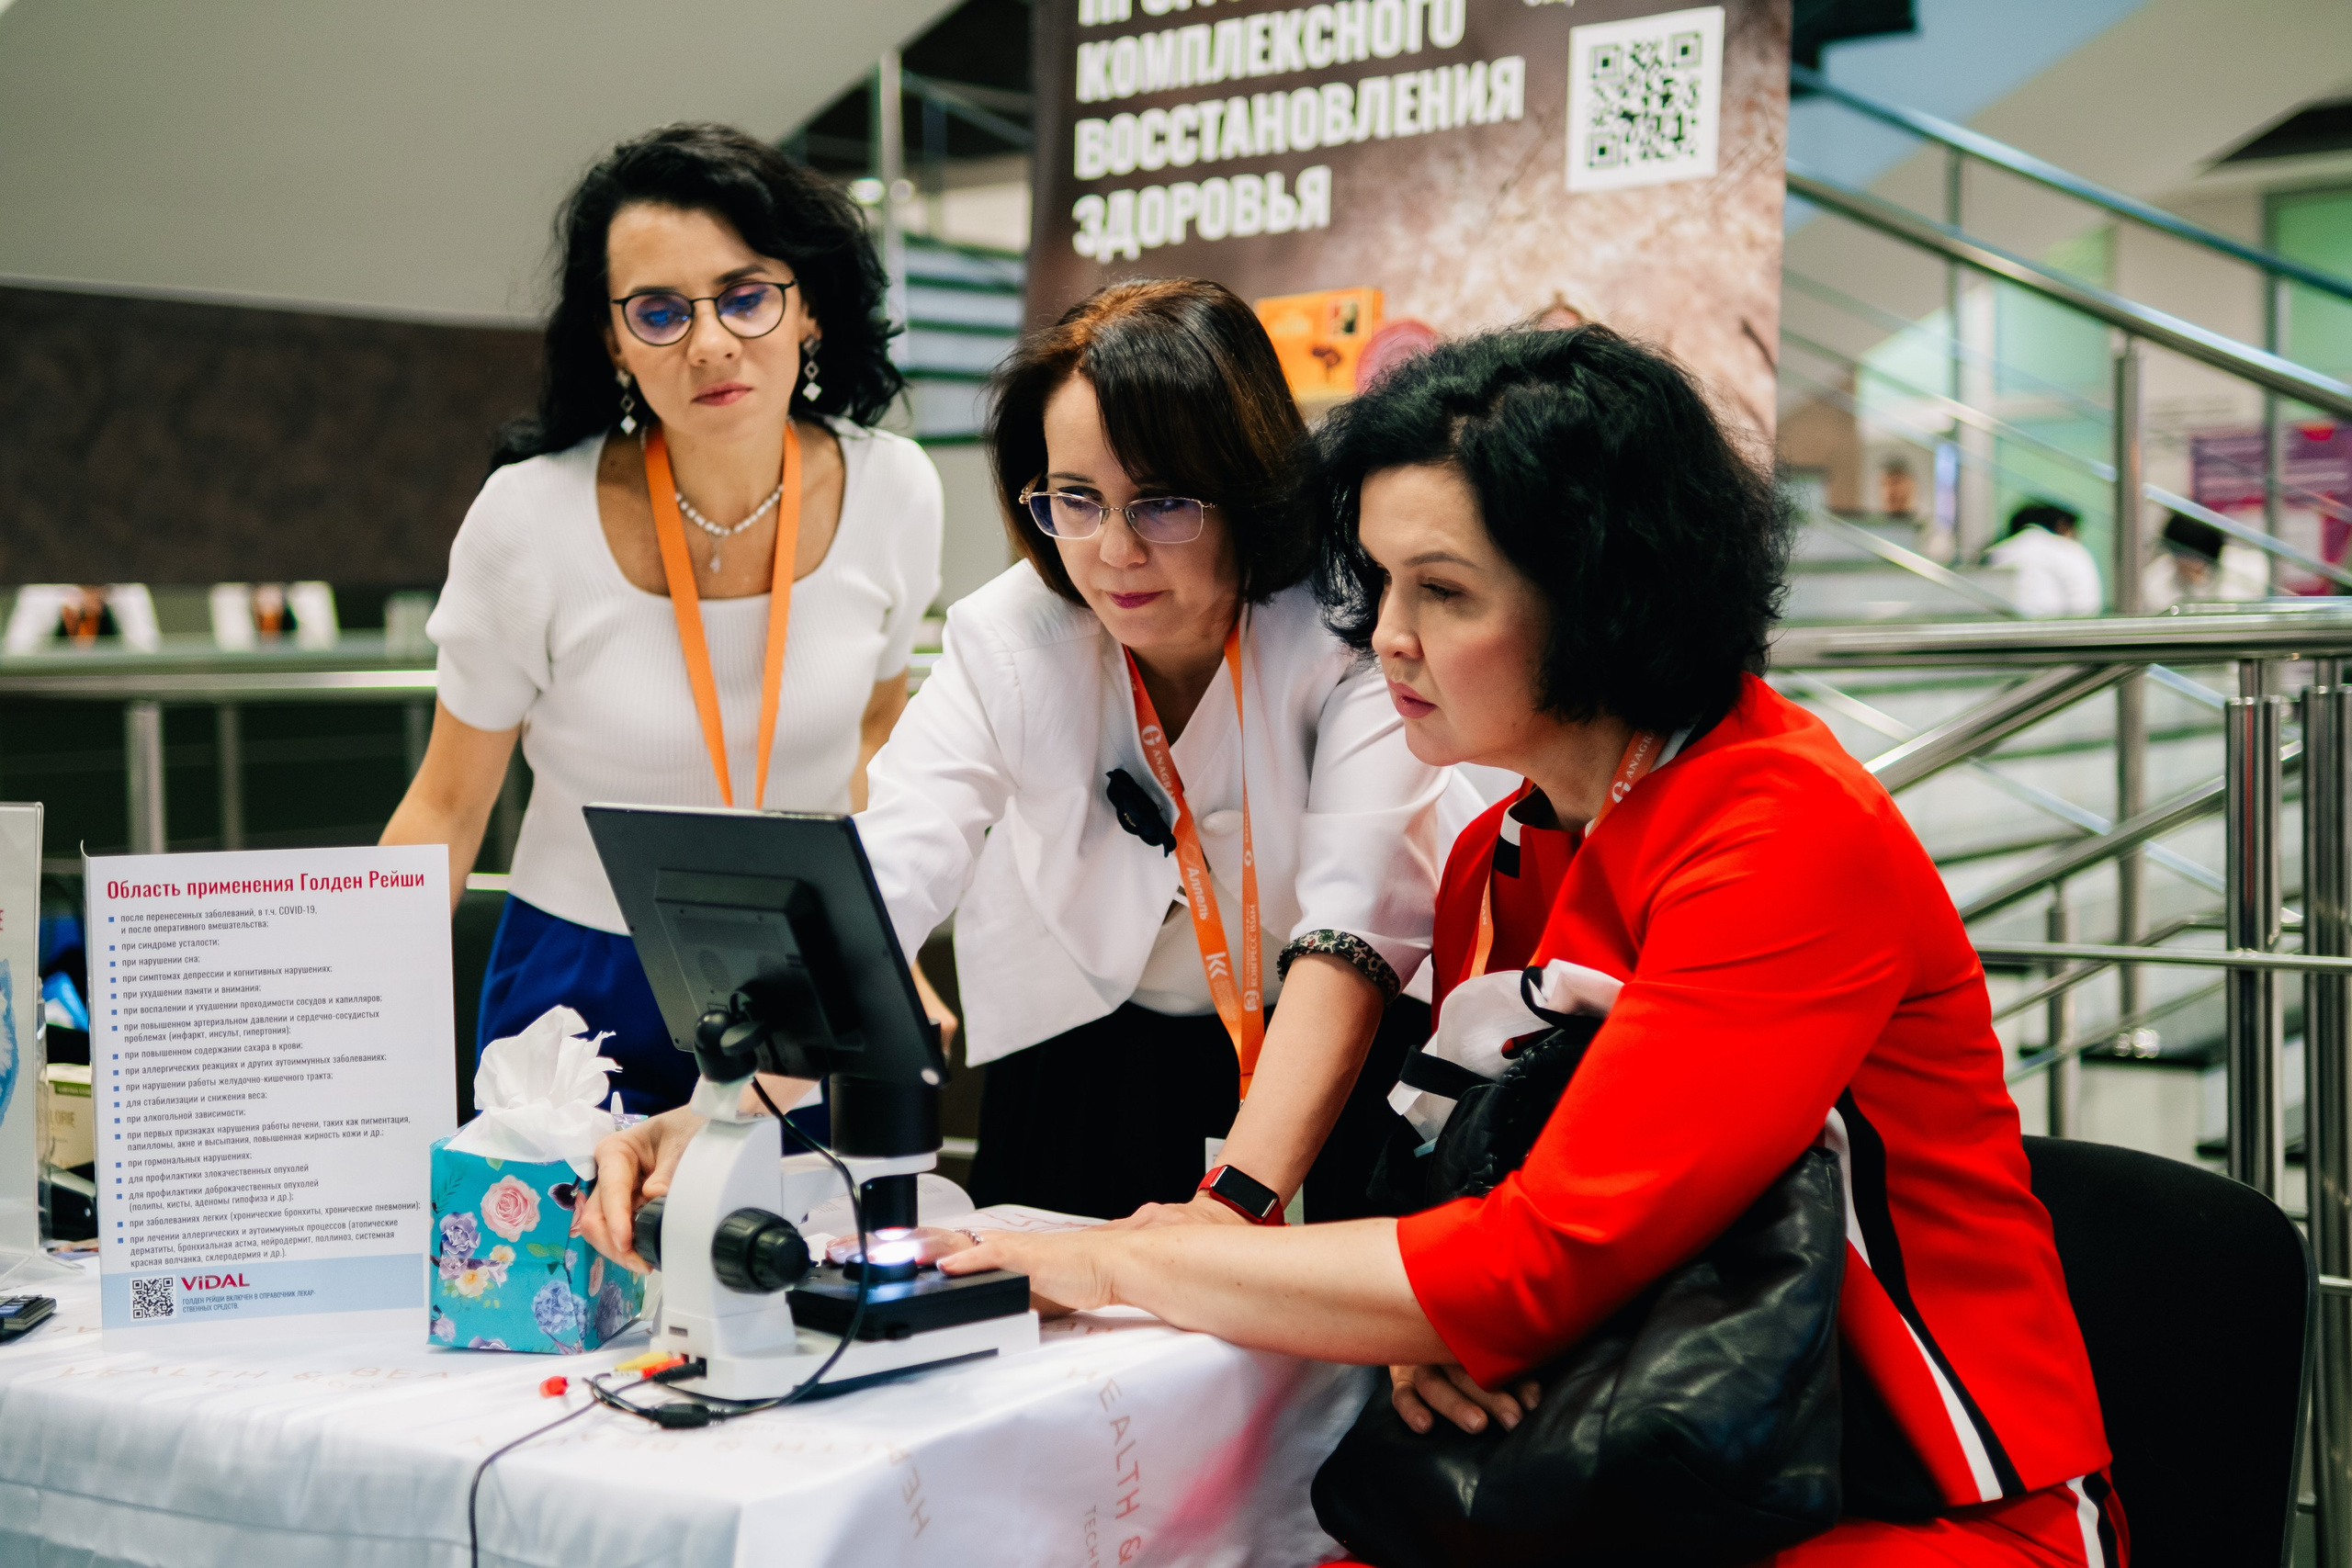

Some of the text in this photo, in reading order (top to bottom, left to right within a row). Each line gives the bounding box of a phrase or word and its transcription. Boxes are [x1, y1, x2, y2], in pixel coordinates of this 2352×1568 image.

[1076, 0, 1466, 102] КОМПЛЕКСНОГО
[1074, 55, 1526, 180] ВОССТАНОВЛЕНИЯ
[1072, 165, 1332, 262] ЗДОРОВЬЯ
[107, 870, 424, 899] Область применения Голден Рейши
[1186, 866, 1209, 920] Аллель
[120, 914, 144, 922] после
[145, 912, 203, 922] перенесенных
[257, 908, 263, 917] в
[128, 926, 152, 934] после
[153, 923, 206, 934] оперативного
[121, 942, 136, 952] при
[138, 941, 176, 951] синдроме
[121, 959, 137, 968] при
[138, 957, 182, 967] нарушении
[1250, 933, 1258, 987] КОНГРЕСС
[122, 975, 137, 984] при
[139, 973, 181, 982] симптомах
[182, 971, 224, 981] депрессии
[232, 968, 282, 977] когнитивных
[122, 991, 138, 1000] при
[139, 988, 183, 999] ухудшении
[123, 1007, 138, 1017] при
[140, 1005, 187, 1014] воспалении
[195, 1002, 238, 1012] ухудшении
[240, 999, 294, 1010] проходимости
[296, 998, 326, 1007] сосудов
[123, 1023, 139, 1032] при
[140, 1021, 191, 1030] повышенном
[193, 1018, 248, 1029] артериальном
[250, 1016, 288, 1025] давлении
[296, 1010, 379, 1023] сердечно-сосудистых
[124, 1032, 166, 1044] проблемах
[124, 1051, 140, 1061] при
[141, 1048, 192, 1058] повышенном
[194, 1045, 242, 1055] содержании
[243, 1043, 270, 1053] сахара
[125, 1067, 140, 1077] при
[141, 1064, 200, 1075] аллергических
[201, 1062, 238, 1072] реакциях
[246, 1060, 273, 1069] других
[275, 1056, 331, 1067] аутоиммунных
[125, 1083, 141, 1093] при
[141, 1080, 187, 1091] нарушении
[187, 1077, 217, 1089] работы
[218, 1074, 305, 1086] желудочно-кишечного
[125, 1100, 141, 1109] для
[142, 1096, 198, 1106] стабилизации
[207, 1093, 246, 1102] снижения
[126, 1115, 141, 1125] при
[143, 1112, 193, 1122] алкогольной
[127, 1132, 141, 1141] при
[143, 1130, 173, 1140] первых
[175, 1127, 215, 1138] признаках
[217, 1124, 260, 1134] нарушения
[261, 1122, 290, 1133] работы
[322, 1119, 344, 1127] таких
[176, 1140, 196, 1148] акне
[253, 1134, 302, 1144] повышенная
[303, 1132, 341, 1141] жирность
[128, 1159, 142, 1169] при
[144, 1156, 201, 1168] гормональных
[128, 1165, 309, 1185] для профилактики злокачественных опухолей
[128, 1180, 319, 1201] для профилактики доброкачественных опухолей
[194, 1198, 230, 1208] аденомы
[232, 1194, 268, 1204] гипофиза
[129, 1220, 144, 1229] при
[146, 1215, 200, 1226] заболеваниях
[202, 1213, 228, 1223] легких
[230, 1210, 282, 1222] (хронические
[324, 1204, 373, 1216] хронические
[130, 1235, 144, 1245] при
[146, 1234, 180, 1242] лечении
[181, 1229, 240, 1240] аллергических
[248, 1224, 304, 1236] аутоиммунных
[306, 1222, 346, 1233] процессов
[348, 1219, 399, 1231] (атопические
[177, 1241, 232, 1253] бронхиальная
[355, 1231, 395, 1240] системная
[130, 1258, 163, 1269] красная
[205, 1251, 261, 1262] склеродермия
[182, 1297, 205, 1305] ГОЛДЕН
[205, 1294, 225, 1303] РЕЙШИ
[225, 1293, 254, 1303] ВКЛЮЧЕН
[258, 1291, 296, 1300] СПРАВОЧНИК
[297, 1289, 315, 1297] ЛЕКАР-
[182, 1304, 212, 1314] СТВЕННЫХ
[1118, 1536, 1142, 1565] &
